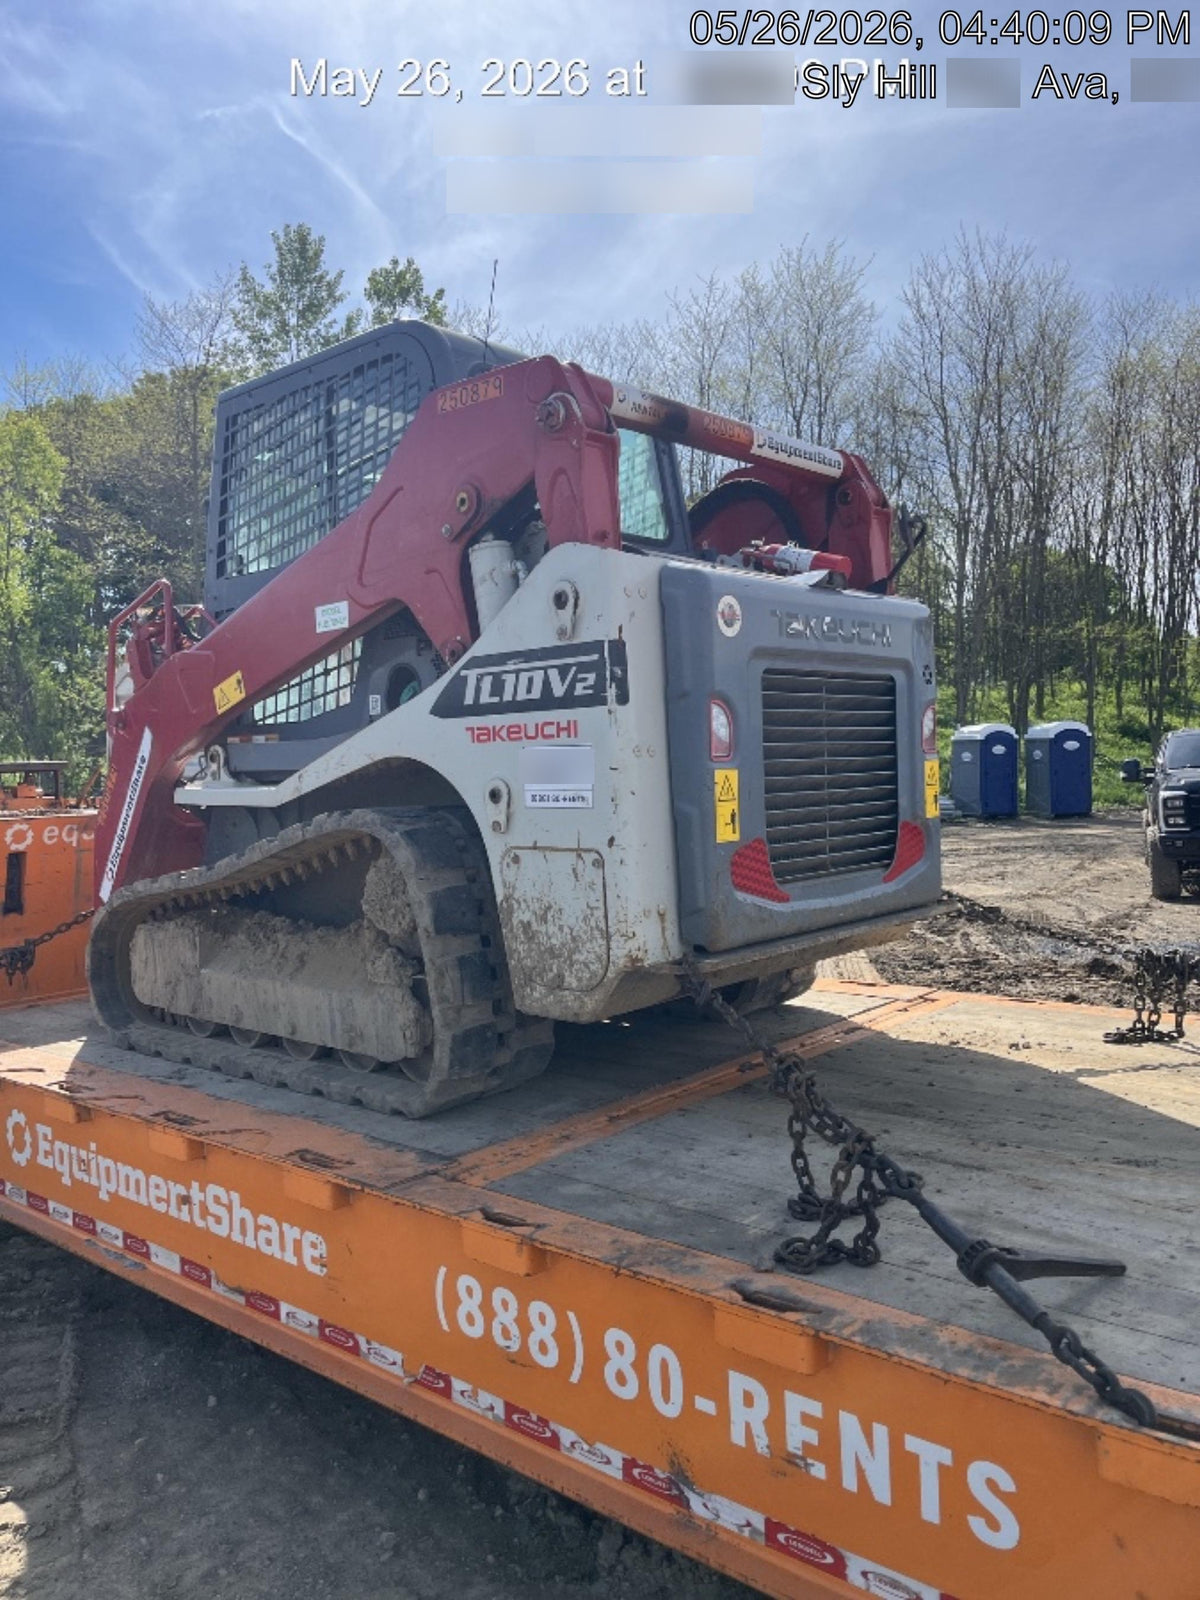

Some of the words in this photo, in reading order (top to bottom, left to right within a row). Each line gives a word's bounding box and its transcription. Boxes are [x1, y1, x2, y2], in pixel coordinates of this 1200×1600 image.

[438, 375, 503, 413] 250879
[770, 608, 892, 648] TAKEUCHI
[459, 654, 599, 706] TL10V2
[466, 719, 579, 744] TAKEUCHI
[36, 1123, 328, 1276] EquipmentShare
[435, 1265, 584, 1383] (888)
[603, 1327, 1021, 1551] 80-RENTS
